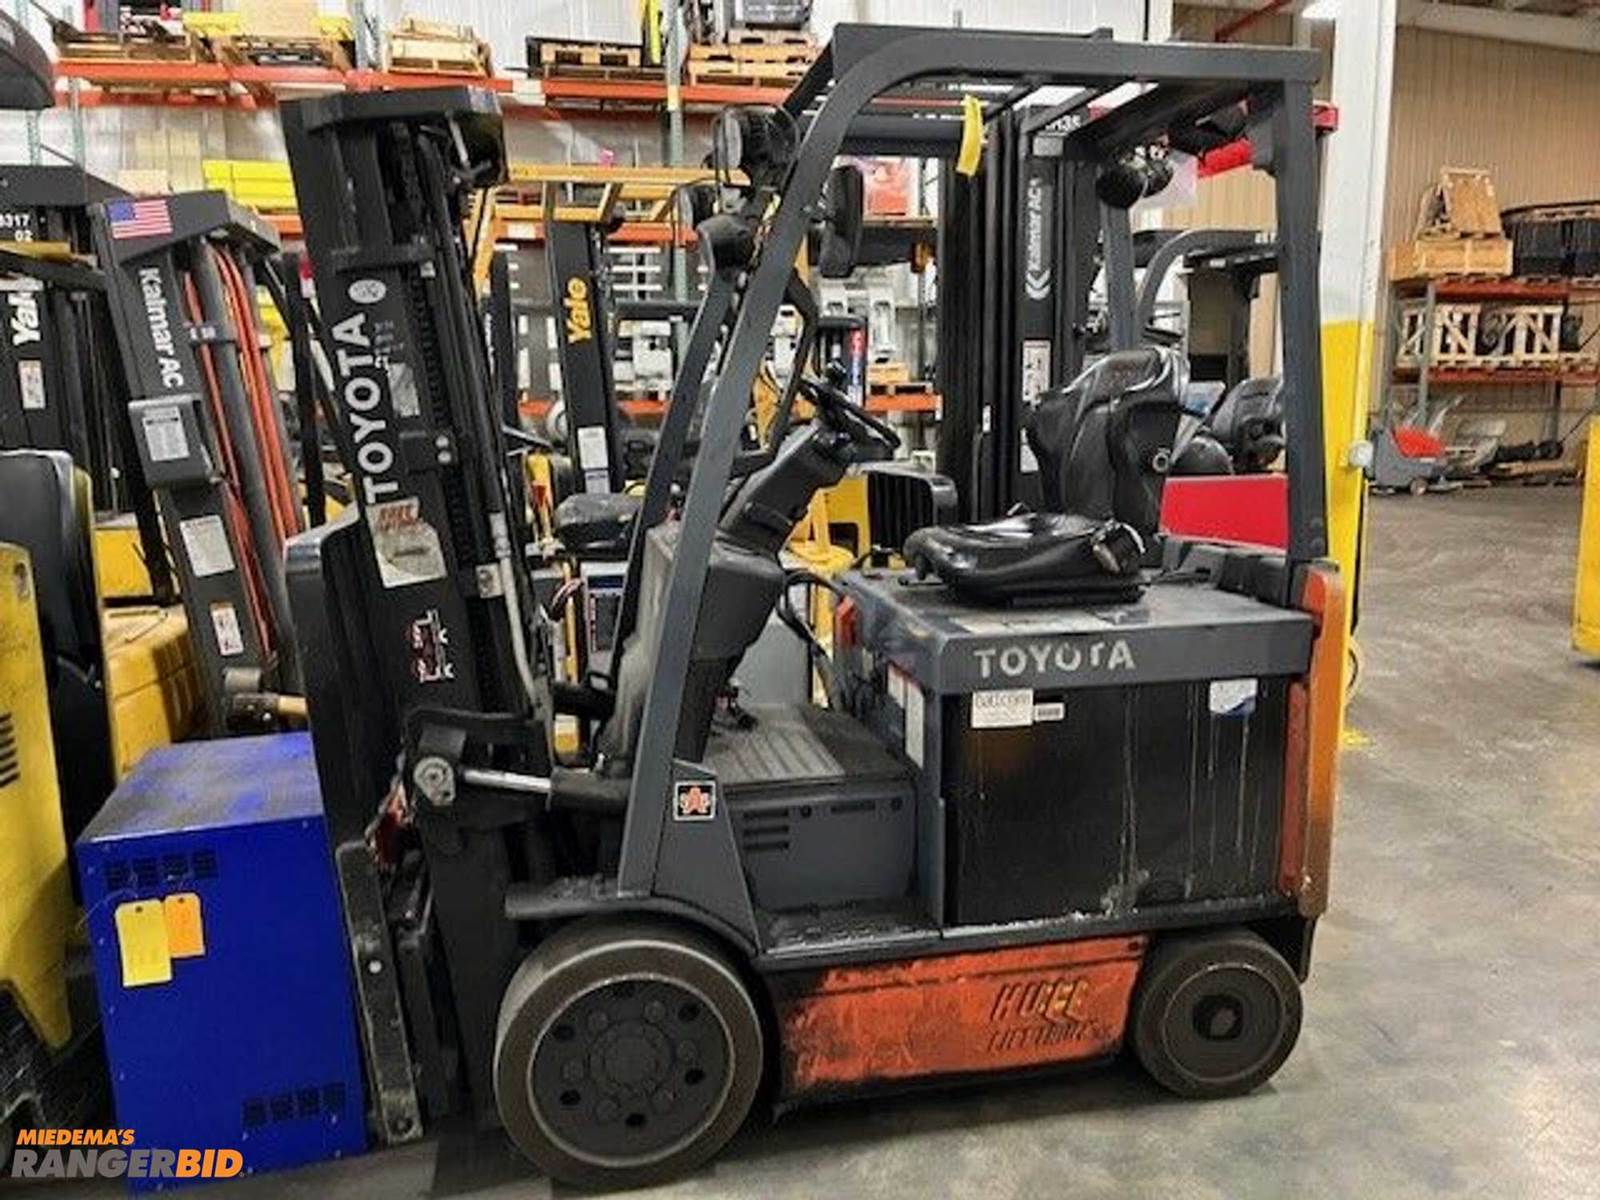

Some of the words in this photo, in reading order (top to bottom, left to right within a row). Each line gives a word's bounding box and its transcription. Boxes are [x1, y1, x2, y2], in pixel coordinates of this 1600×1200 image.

[8, 291, 41, 346] Yal
[139, 267, 175, 356] Kalmar
[159, 357, 184, 389] AC
[563, 277, 593, 343] Yale
[332, 312, 399, 504] TOYOTA
[974, 639, 1136, 678] TOYOTA
